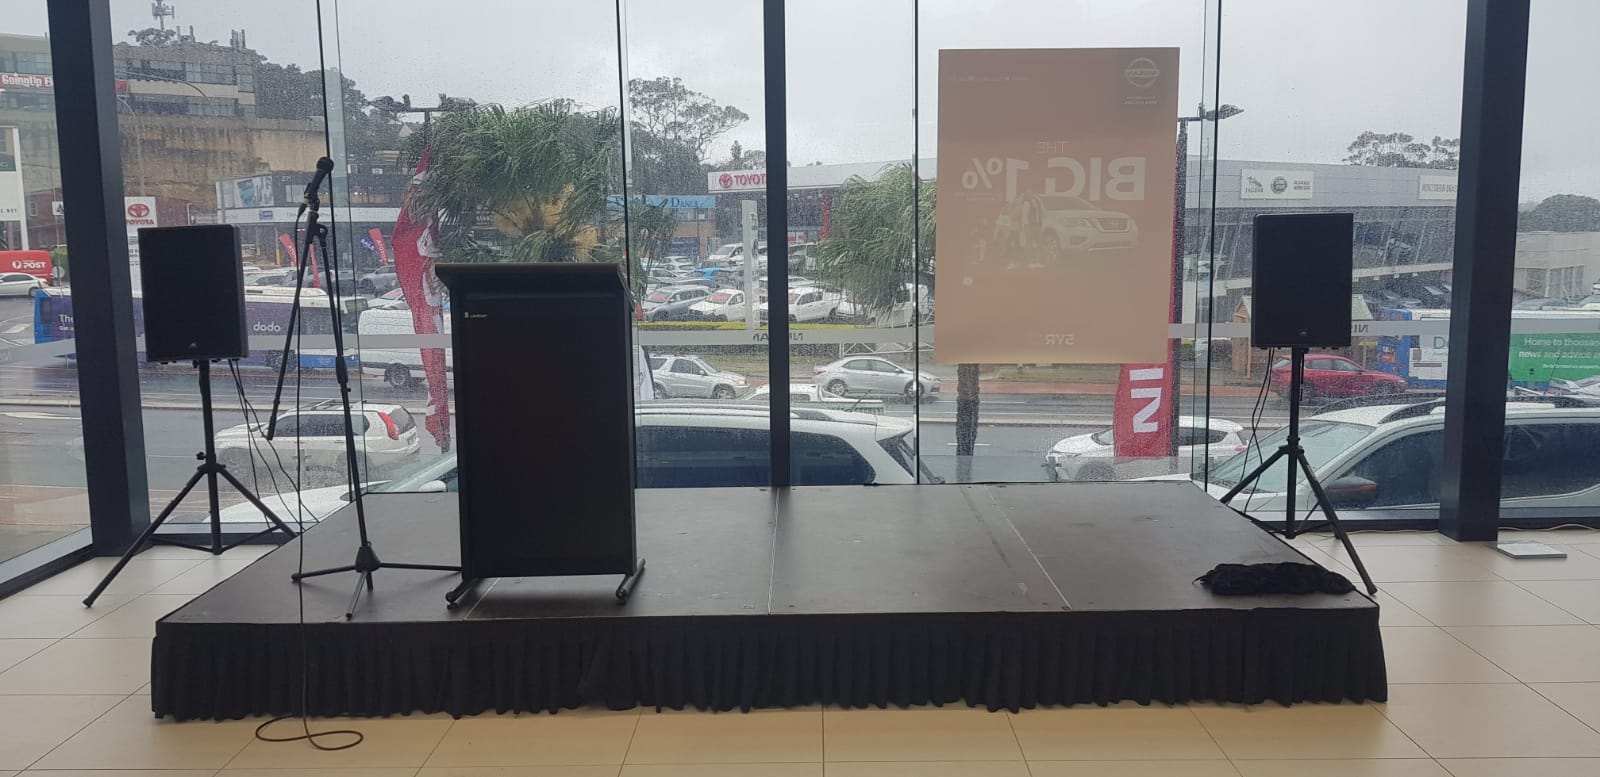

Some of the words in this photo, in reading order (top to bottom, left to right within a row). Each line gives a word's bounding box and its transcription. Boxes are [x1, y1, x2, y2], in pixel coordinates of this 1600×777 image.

[253, 321, 281, 332] dodo
[1434, 336, 1450, 349] D
[1524, 338, 1551, 346] Home
[1553, 338, 1563, 346] to
[1543, 350, 1560, 358] and
[1561, 350, 1592, 358] advice
